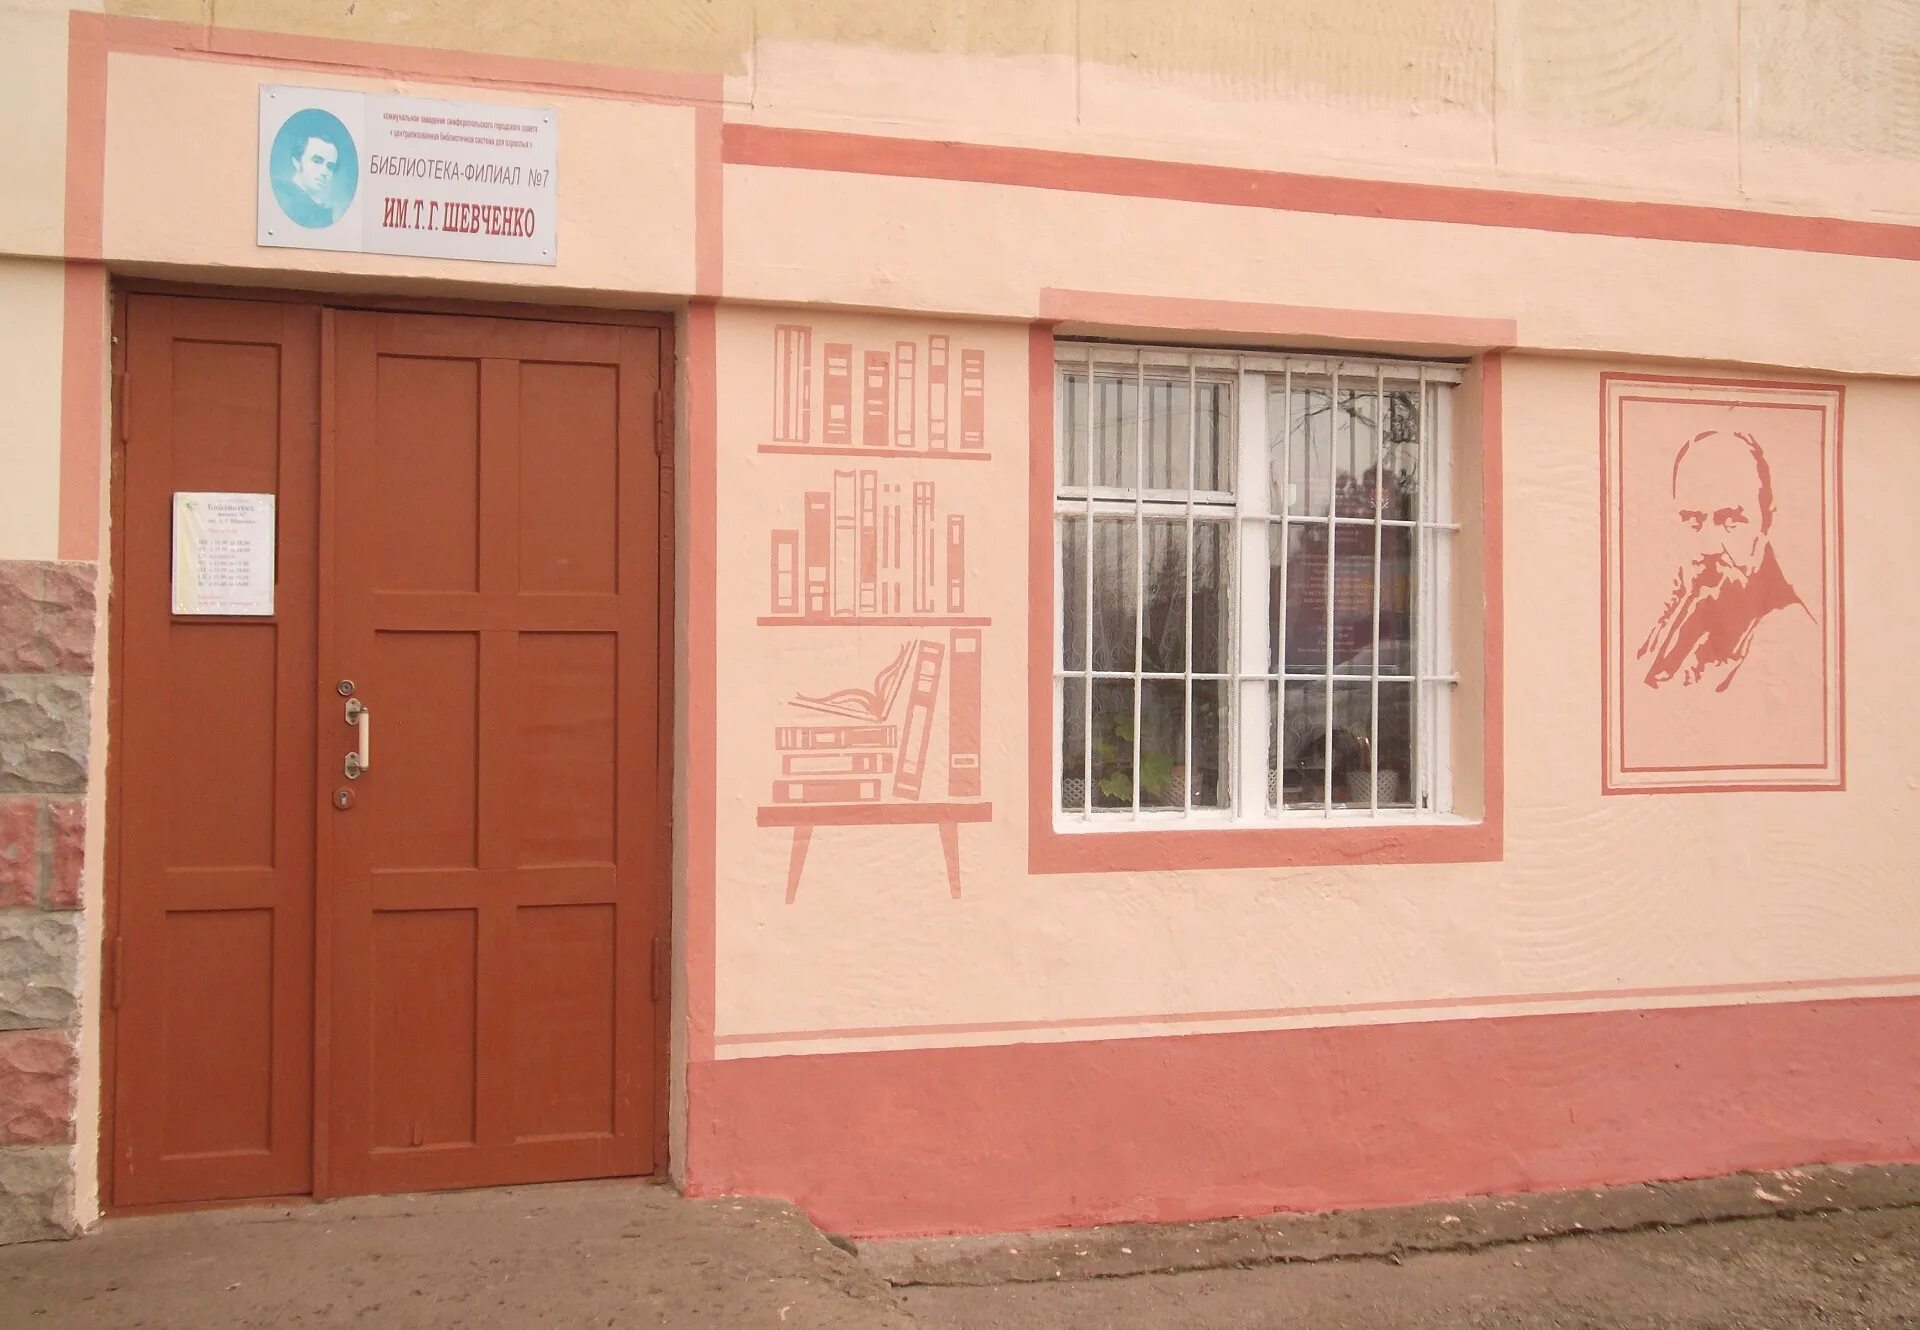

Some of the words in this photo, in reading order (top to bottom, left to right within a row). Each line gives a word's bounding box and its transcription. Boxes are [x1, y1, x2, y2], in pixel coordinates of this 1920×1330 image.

[370, 154, 521, 186] БИБЛИОТЕКА-ФИЛИАЛ
[527, 167, 550, 187] №7
[442, 201, 536, 238] ШЕВЧЕНКО
